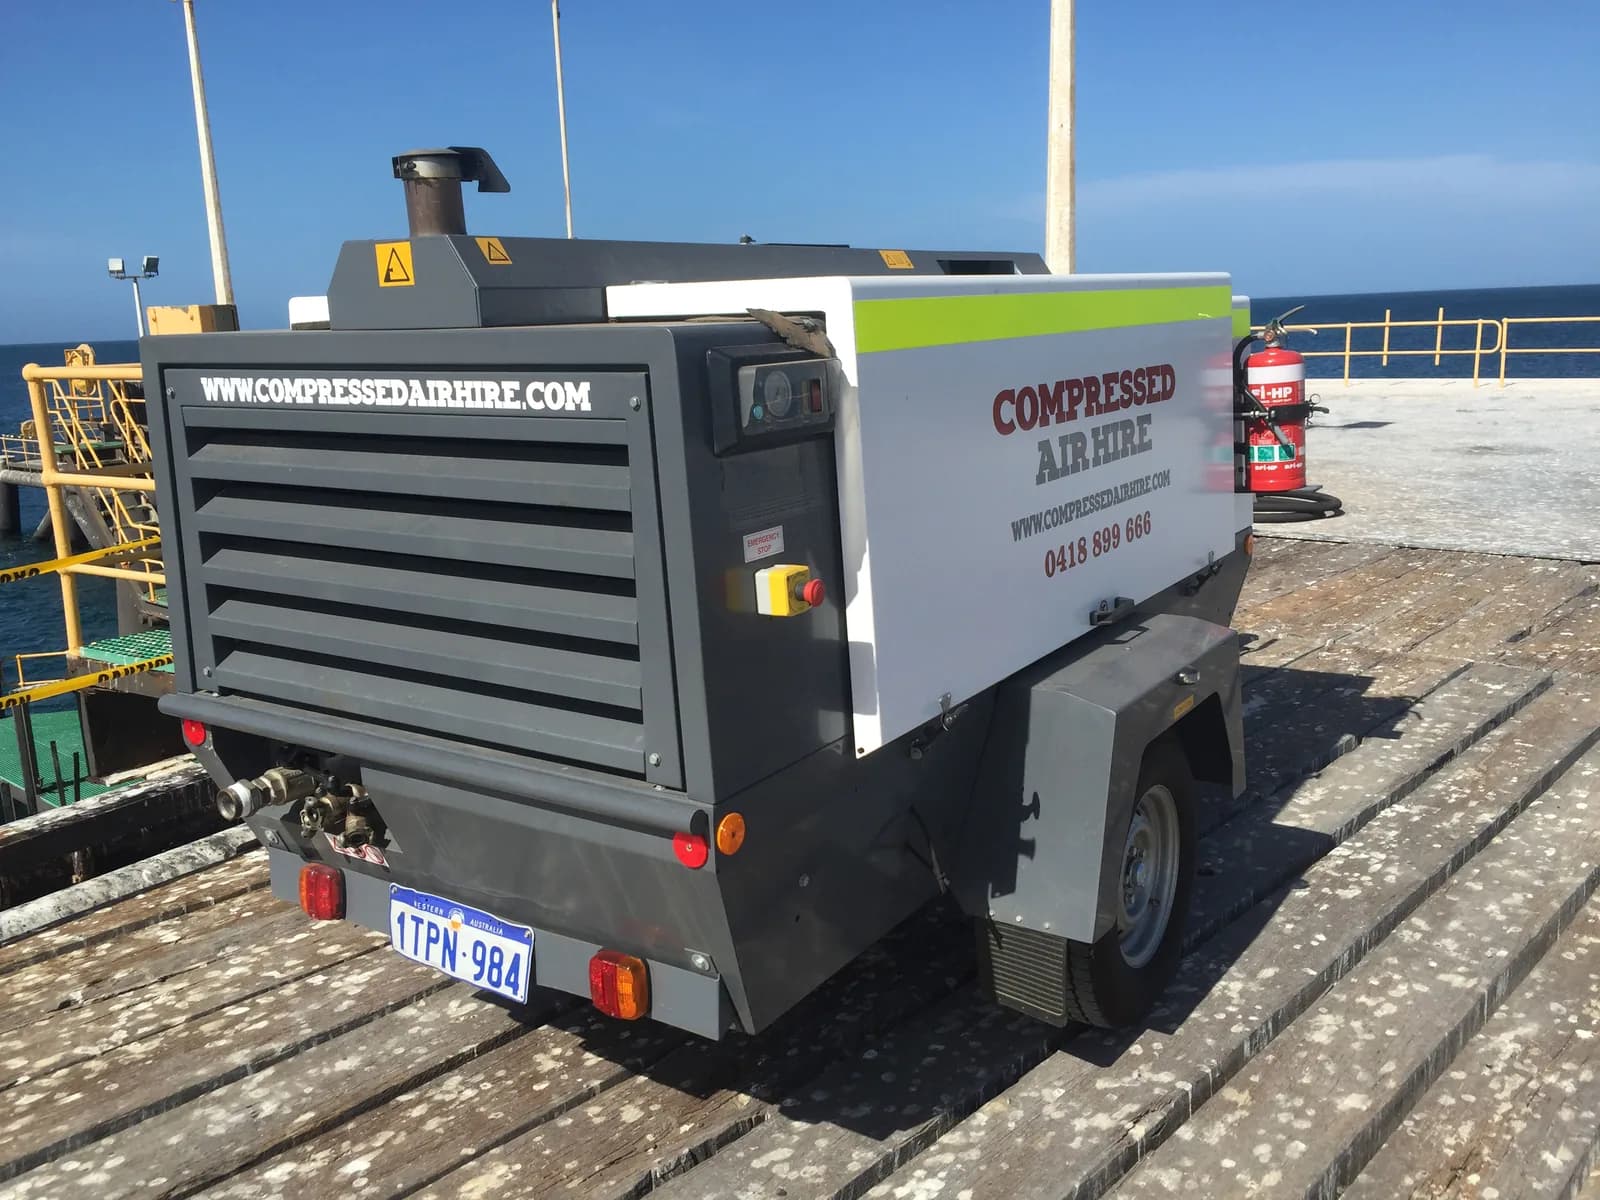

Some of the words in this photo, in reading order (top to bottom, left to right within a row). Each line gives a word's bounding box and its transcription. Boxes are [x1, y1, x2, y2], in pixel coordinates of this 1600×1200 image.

[200, 378, 592, 411] WWW.COMPRESSEDAIRHIRE.COM
[992, 363, 1176, 436] COMPRESSED
[1035, 431, 1090, 486] AIR
[1091, 414, 1153, 468] HIRE
[1011, 469, 1171, 543] WWW.COMPRESSEDAIRHIRE.COM
[747, 532, 780, 548] EMERGENCY
[757, 544, 773, 555] STOP
[1044, 536, 1088, 578] 0418
[1092, 523, 1121, 558] 899
[1125, 510, 1152, 543] 666
[469, 919, 504, 936] AUSTRALIA
